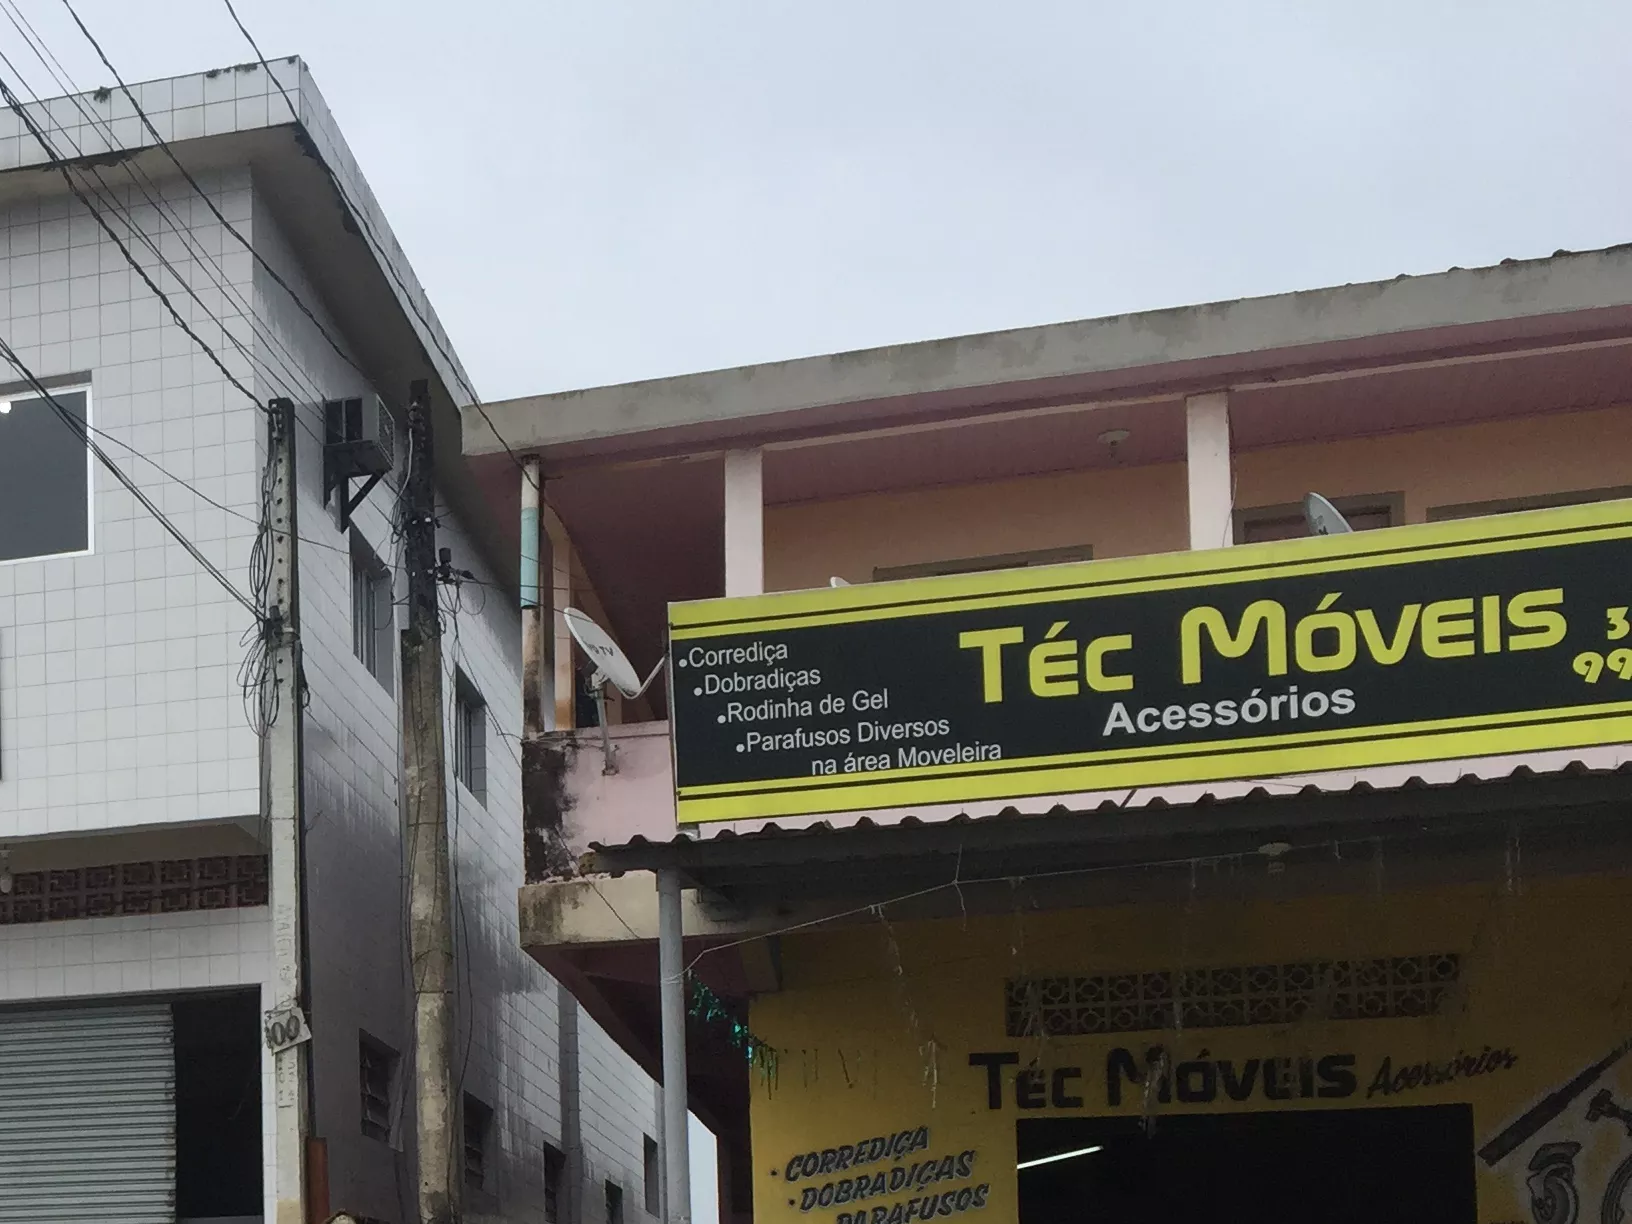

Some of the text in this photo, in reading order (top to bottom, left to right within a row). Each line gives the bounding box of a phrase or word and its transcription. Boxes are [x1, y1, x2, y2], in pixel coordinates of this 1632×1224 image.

[688, 641, 788, 670] Corrediça
[704, 668, 821, 696] Dobradiças
[727, 689, 889, 723] Rodinha de Gel
[1102, 685, 1356, 737] Acessórios
[746, 718, 950, 754] Parafusos Diversos
[811, 743, 1002, 776] na área Moveleira
[785, 1125, 930, 1183] CORREDIÇA
[800, 1150, 976, 1212] DOBRADIÇAS
